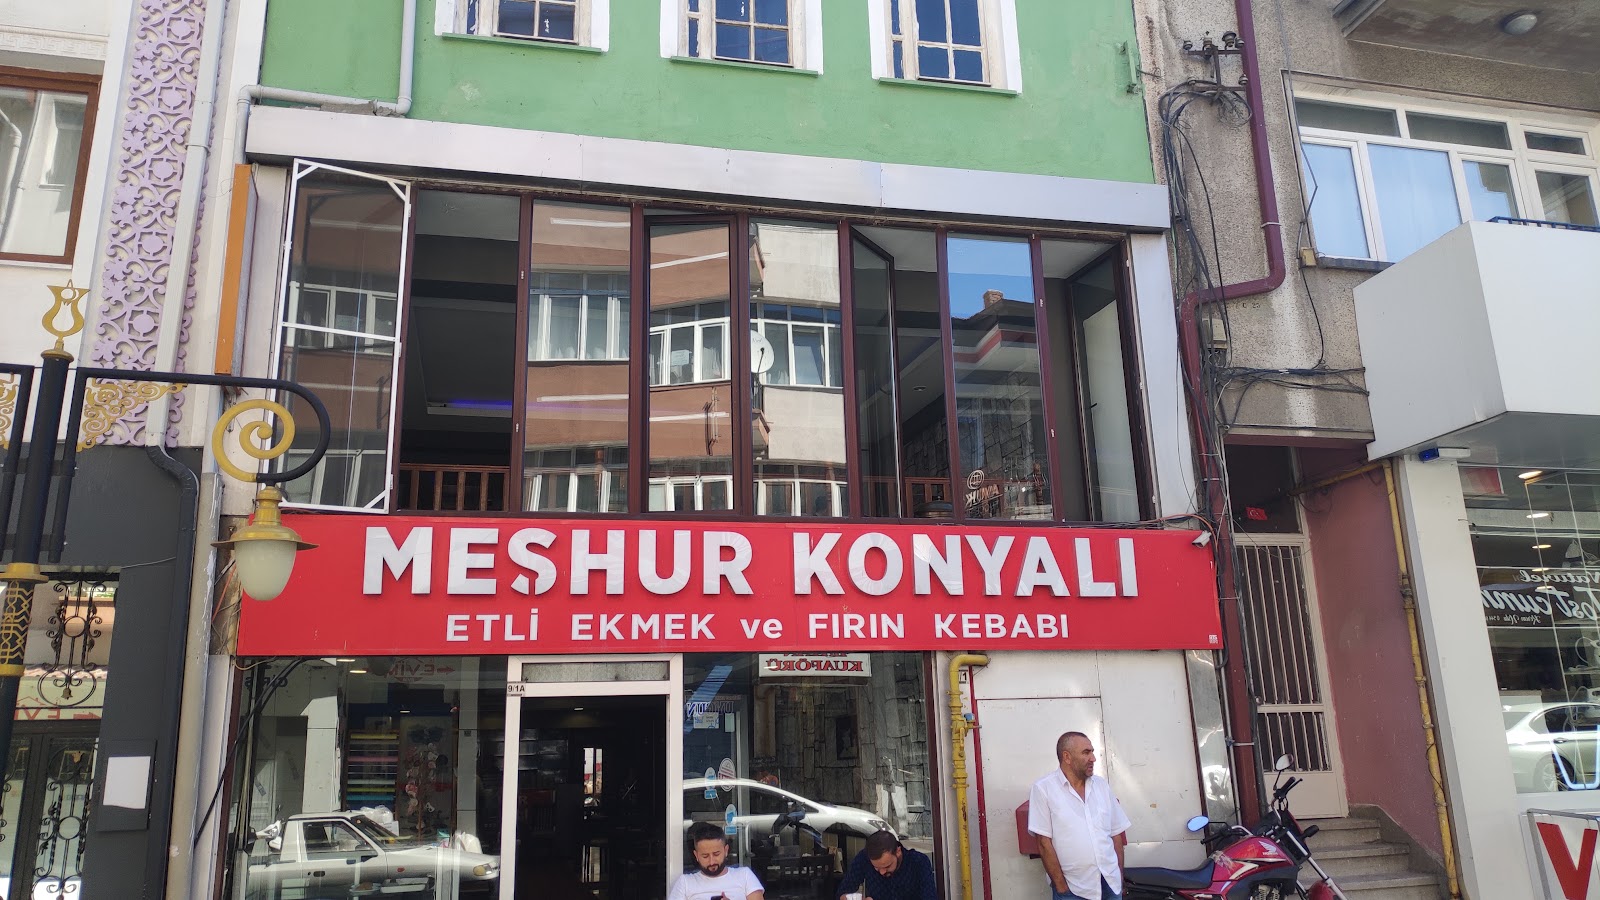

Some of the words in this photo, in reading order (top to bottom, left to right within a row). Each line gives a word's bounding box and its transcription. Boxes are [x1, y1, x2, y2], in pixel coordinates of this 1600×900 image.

[792, 531, 1139, 598] KONYALI
[446, 608, 539, 642] ETLİ
[570, 613, 716, 641] EKMEK
[739, 617, 783, 639] ve
[808, 613, 905, 639] FIRIN
[934, 613, 1069, 639] KEBABI
